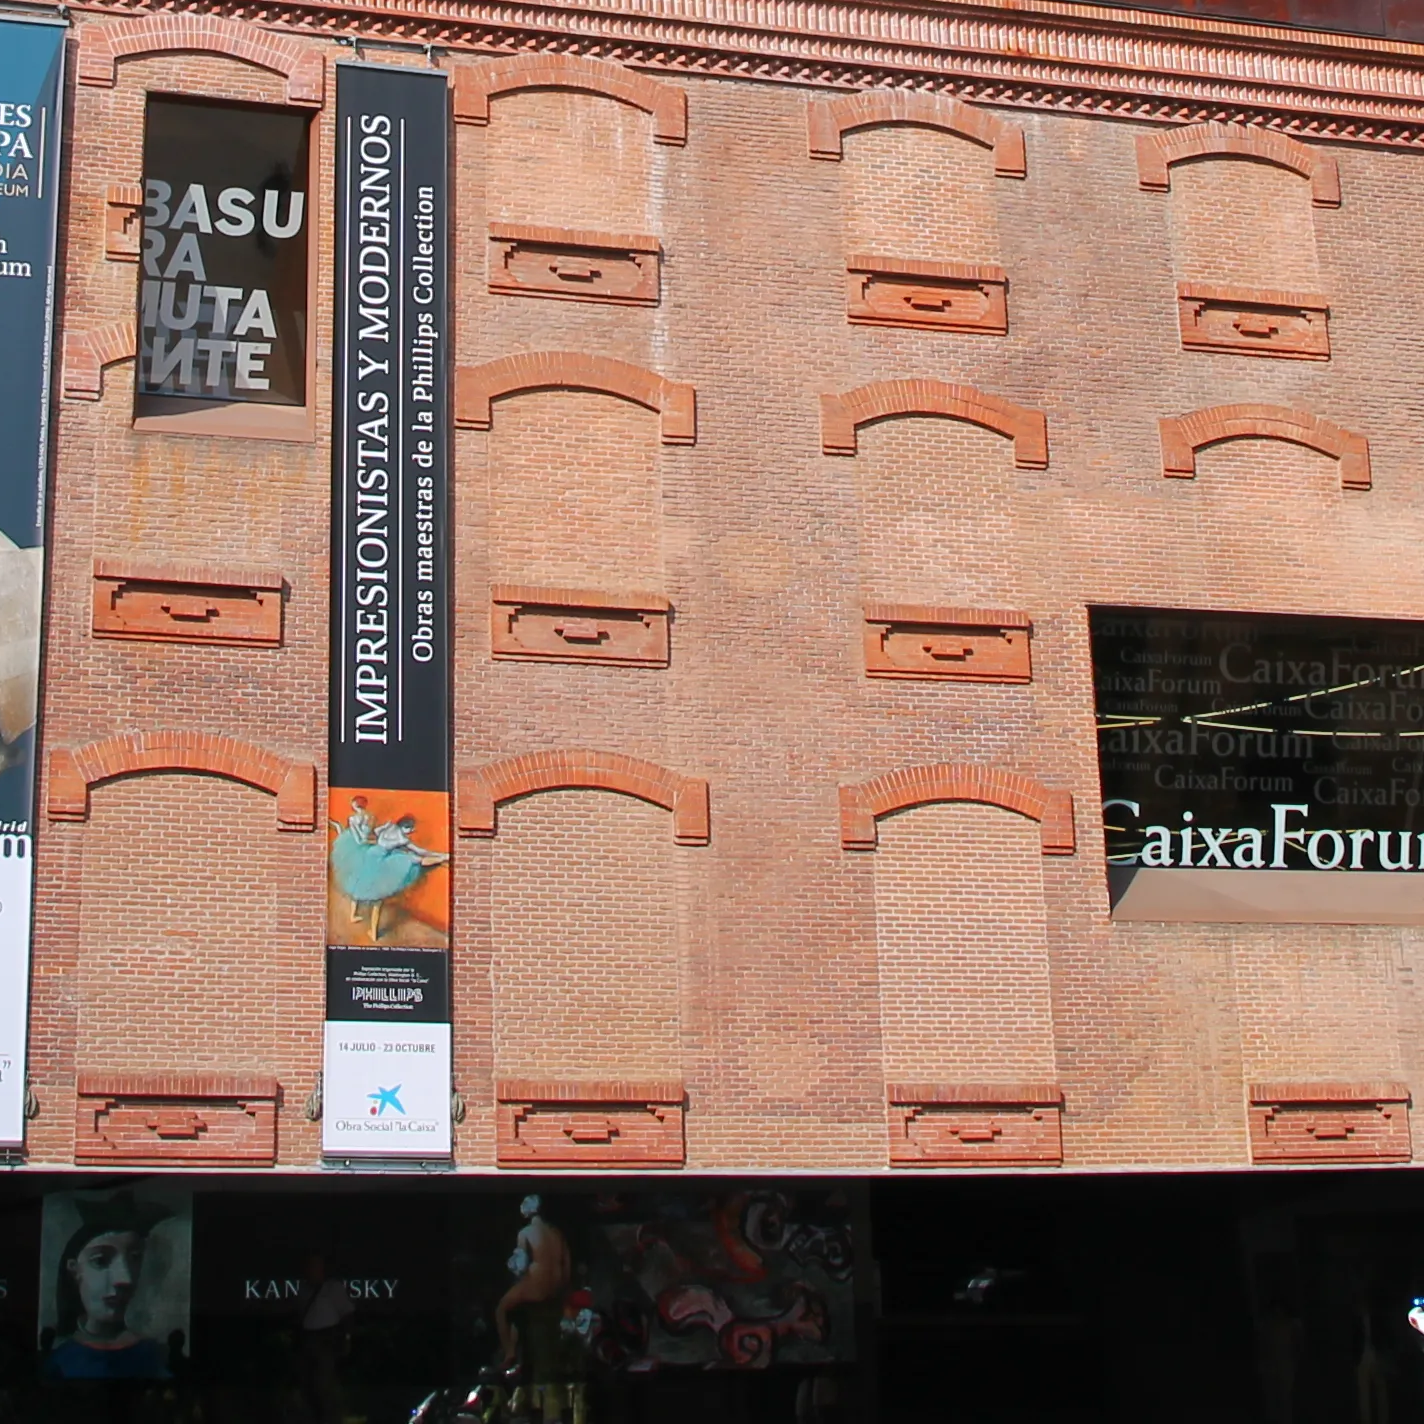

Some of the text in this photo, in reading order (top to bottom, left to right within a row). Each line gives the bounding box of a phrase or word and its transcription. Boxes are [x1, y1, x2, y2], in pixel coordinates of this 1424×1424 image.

[354, 113, 392, 745] IMPRESIONISTAS Y MODERNOS
[410, 185, 439, 664] Obras maestras de la Phillips Collection
[1154, 763, 1294, 793] CaixaForum
[338, 1041, 349, 1052] 14
[350, 1042, 376, 1052] JULIO
[383, 1043, 394, 1053] 23
[395, 1043, 436, 1054] OCTUBRE
[335, 1119, 362, 1132] Obra
[363, 1120, 393, 1132] Social
